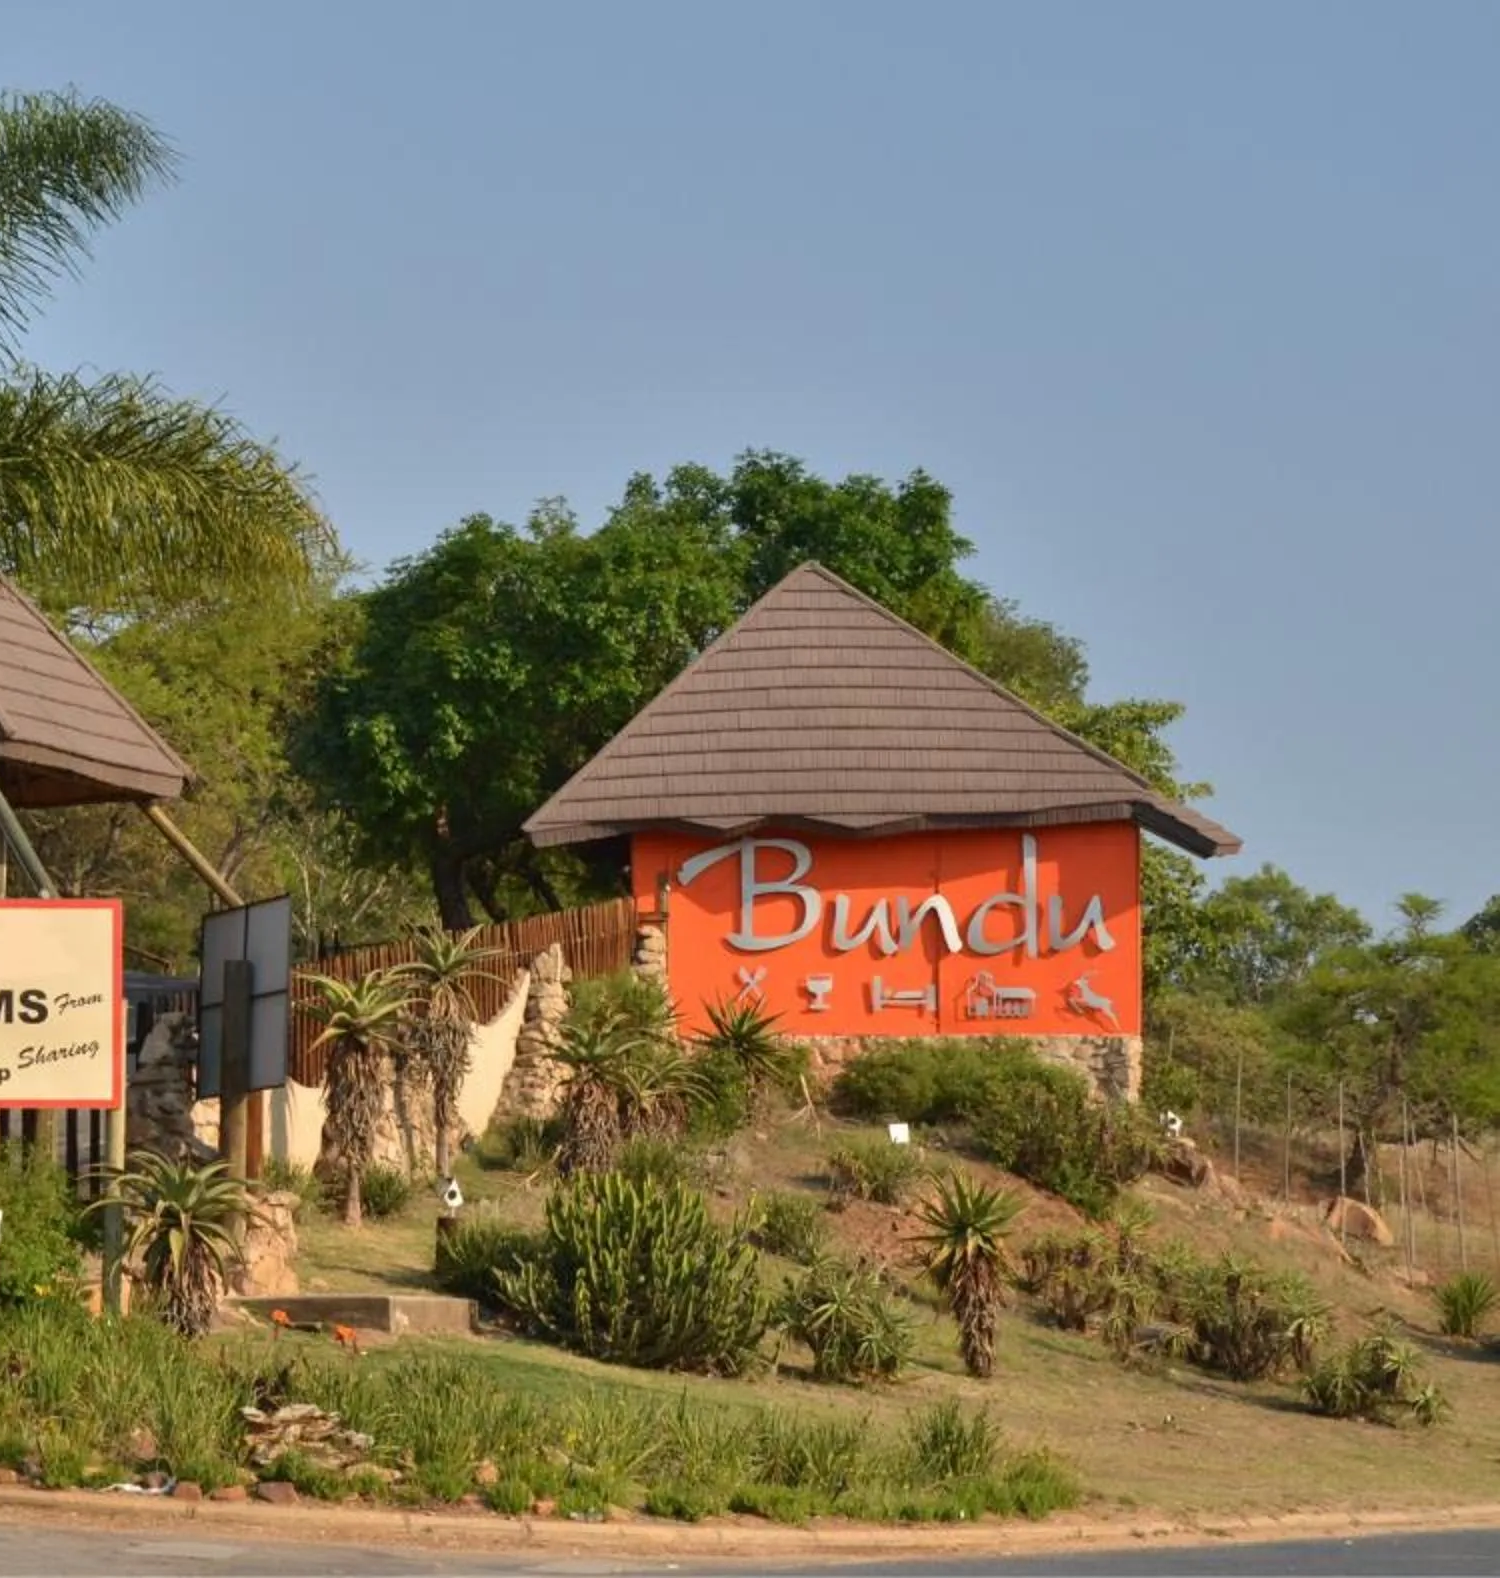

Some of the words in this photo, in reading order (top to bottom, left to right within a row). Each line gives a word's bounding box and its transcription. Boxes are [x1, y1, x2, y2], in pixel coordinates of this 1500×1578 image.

[676, 833, 1116, 959] Bundu
[53, 992, 104, 1016] From
[16, 1039, 102, 1070] Sharing
